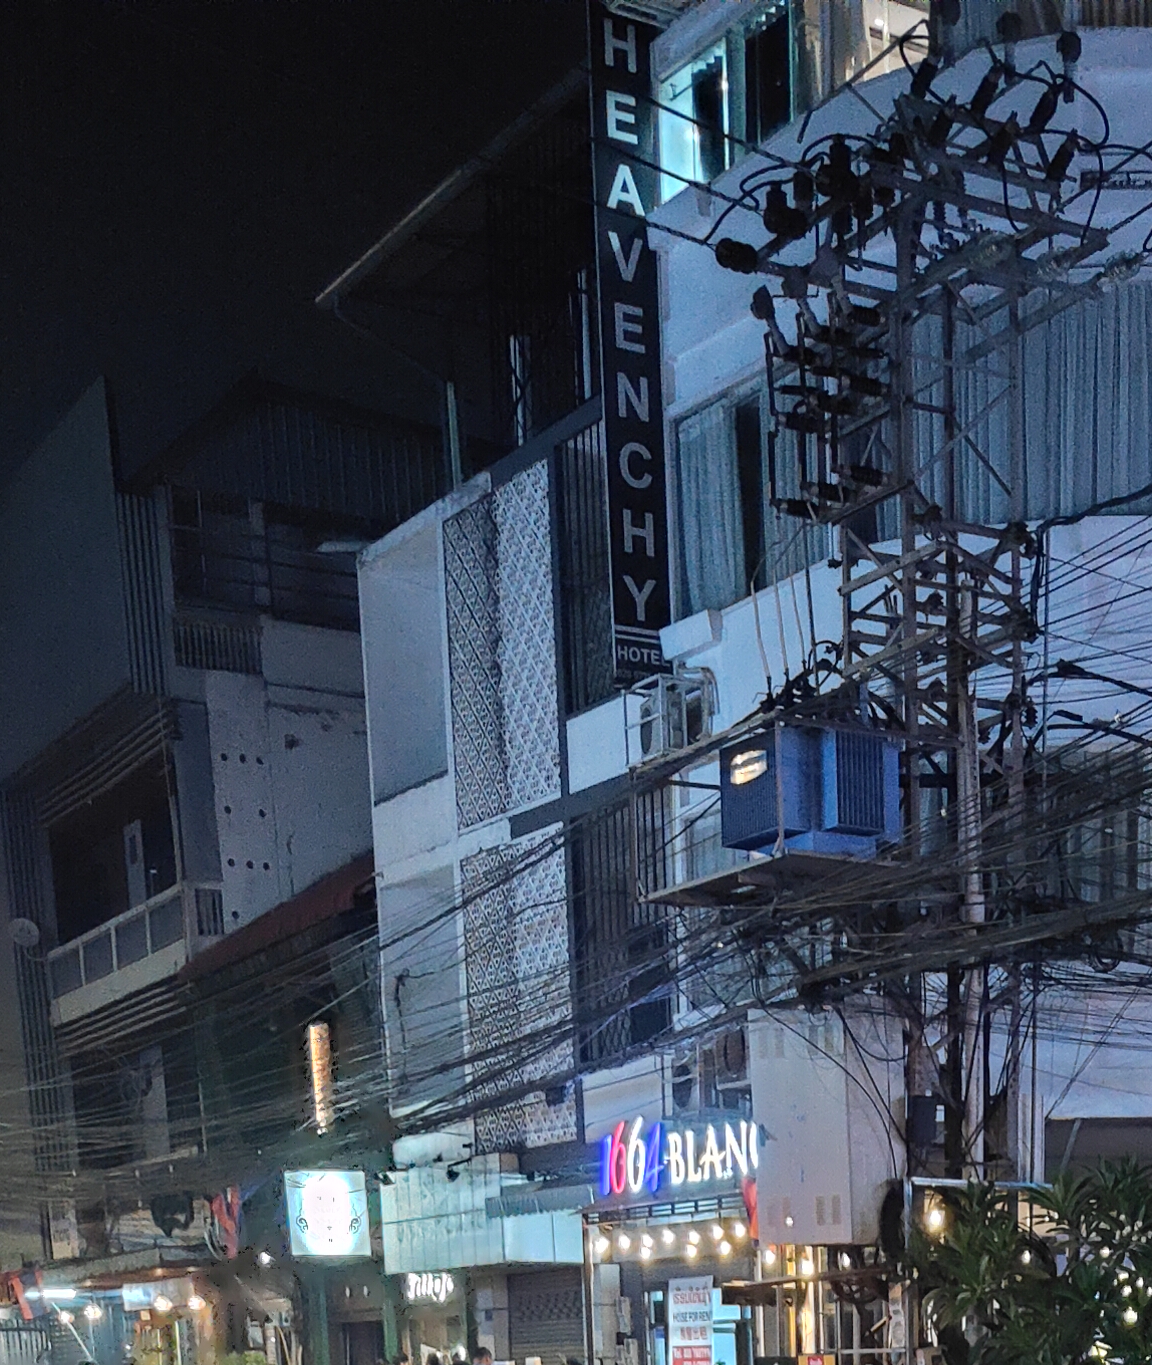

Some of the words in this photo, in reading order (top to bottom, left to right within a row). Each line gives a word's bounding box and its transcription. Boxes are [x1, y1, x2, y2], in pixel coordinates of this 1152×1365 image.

[604, 15, 665, 622] HEAVENCHY
[617, 644, 671, 668] HOTEL
[602, 1114, 664, 1196] 1664
